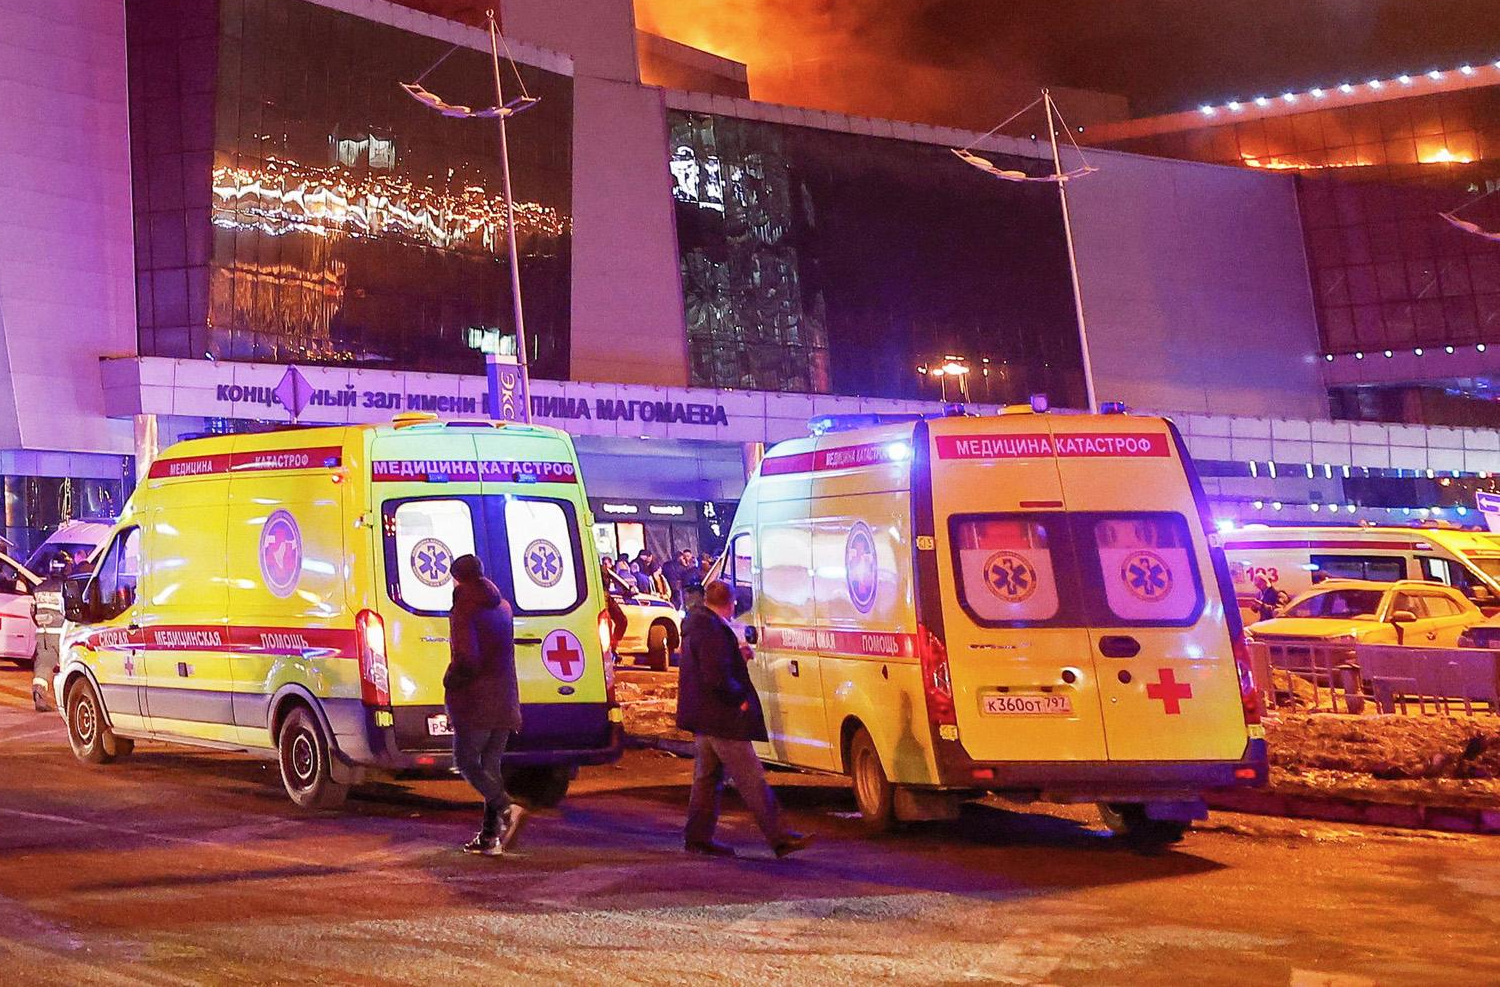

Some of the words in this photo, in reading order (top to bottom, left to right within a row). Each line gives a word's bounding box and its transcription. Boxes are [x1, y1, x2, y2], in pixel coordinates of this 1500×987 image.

[217, 384, 357, 408] конценый
[363, 391, 401, 409] зал
[407, 394, 476, 413] имени
[482, 393, 592, 420] ЛИМА
[596, 399, 729, 426] МАГОМАЕВА
[956, 439, 1051, 457] МЕДИЦИНА
[1055, 438, 1152, 453] КАТАСТРОФ
[170, 460, 213, 476] МЕДИЦИНА
[255, 454, 309, 469] КАТАСТРОФ
[373, 461, 476, 476] МЕДИЦИНА
[479, 462, 575, 476] КАТАСТРОФ
[98, 631, 129, 646] СКОРАЯ
[154, 630, 222, 648] МЕДИЦИНСКАЯ
[260, 632, 309, 650] ПОМОЩЬ
[862, 634, 899, 656] ПОМОЩЬ
